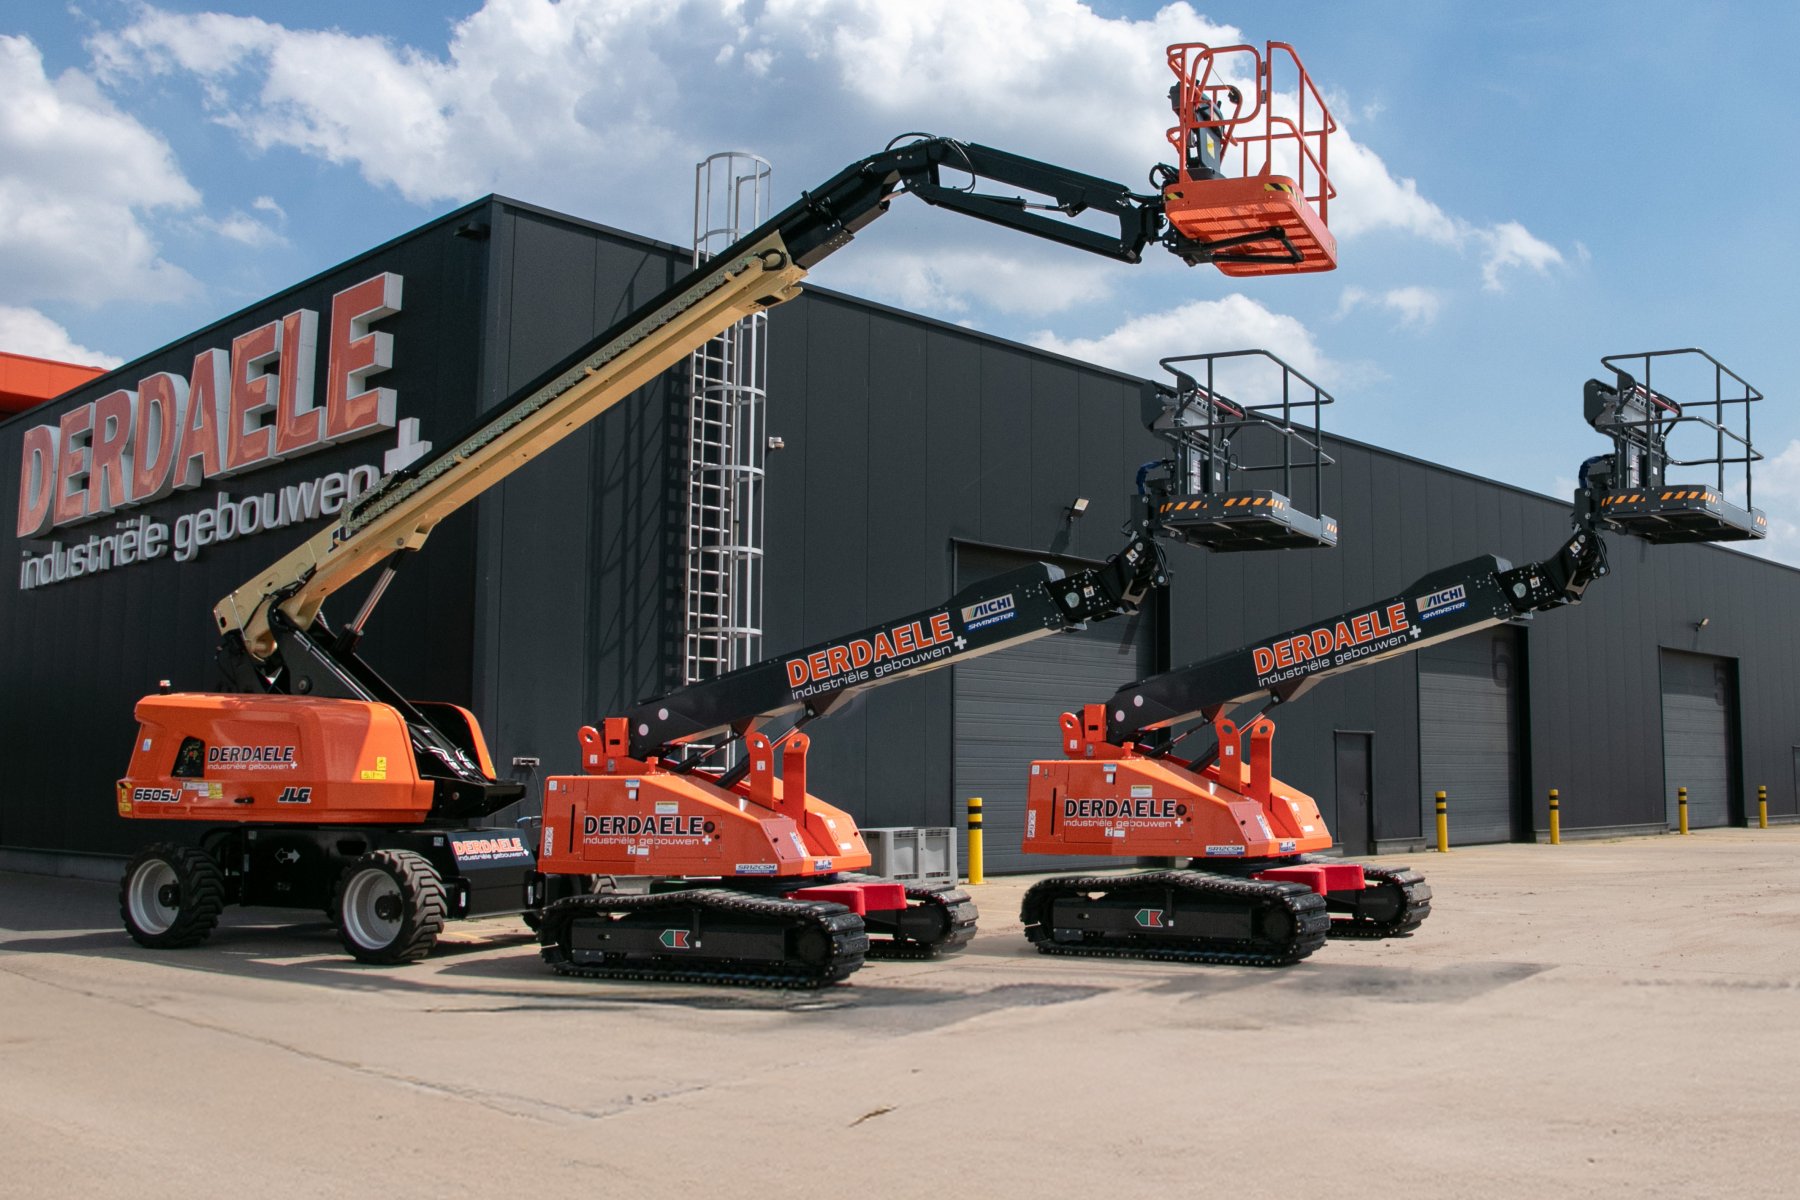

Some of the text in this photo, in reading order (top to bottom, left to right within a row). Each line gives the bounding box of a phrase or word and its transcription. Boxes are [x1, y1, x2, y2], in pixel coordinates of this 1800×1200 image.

[17, 272, 403, 538] DERDAELE
[19, 464, 383, 590] industriële gebouwen
[963, 595, 1012, 621] AICHI
[1418, 586, 1464, 611] AICHI
[967, 611, 1015, 631] SKYMASTER
[1422, 601, 1466, 621] SKYMASTER
[1252, 602, 1409, 676] DERDAELE
[786, 612, 954, 688] DERDAELE
[1257, 634, 1407, 687] industriële gebouwen
[791, 645, 951, 700] industriële gebouwen
[208, 746, 295, 763] DERDAELE
[133, 787, 182, 803] 660SJ
[278, 786, 312, 803] JLG
[1064, 799, 1176, 818] DERDAELE
[584, 815, 704, 836] DERDAELE
[1064, 819, 1171, 828] industriële gebouwen
[452, 837, 523, 855] DERDAELE
[583, 836, 699, 846] industriële gebouwen
